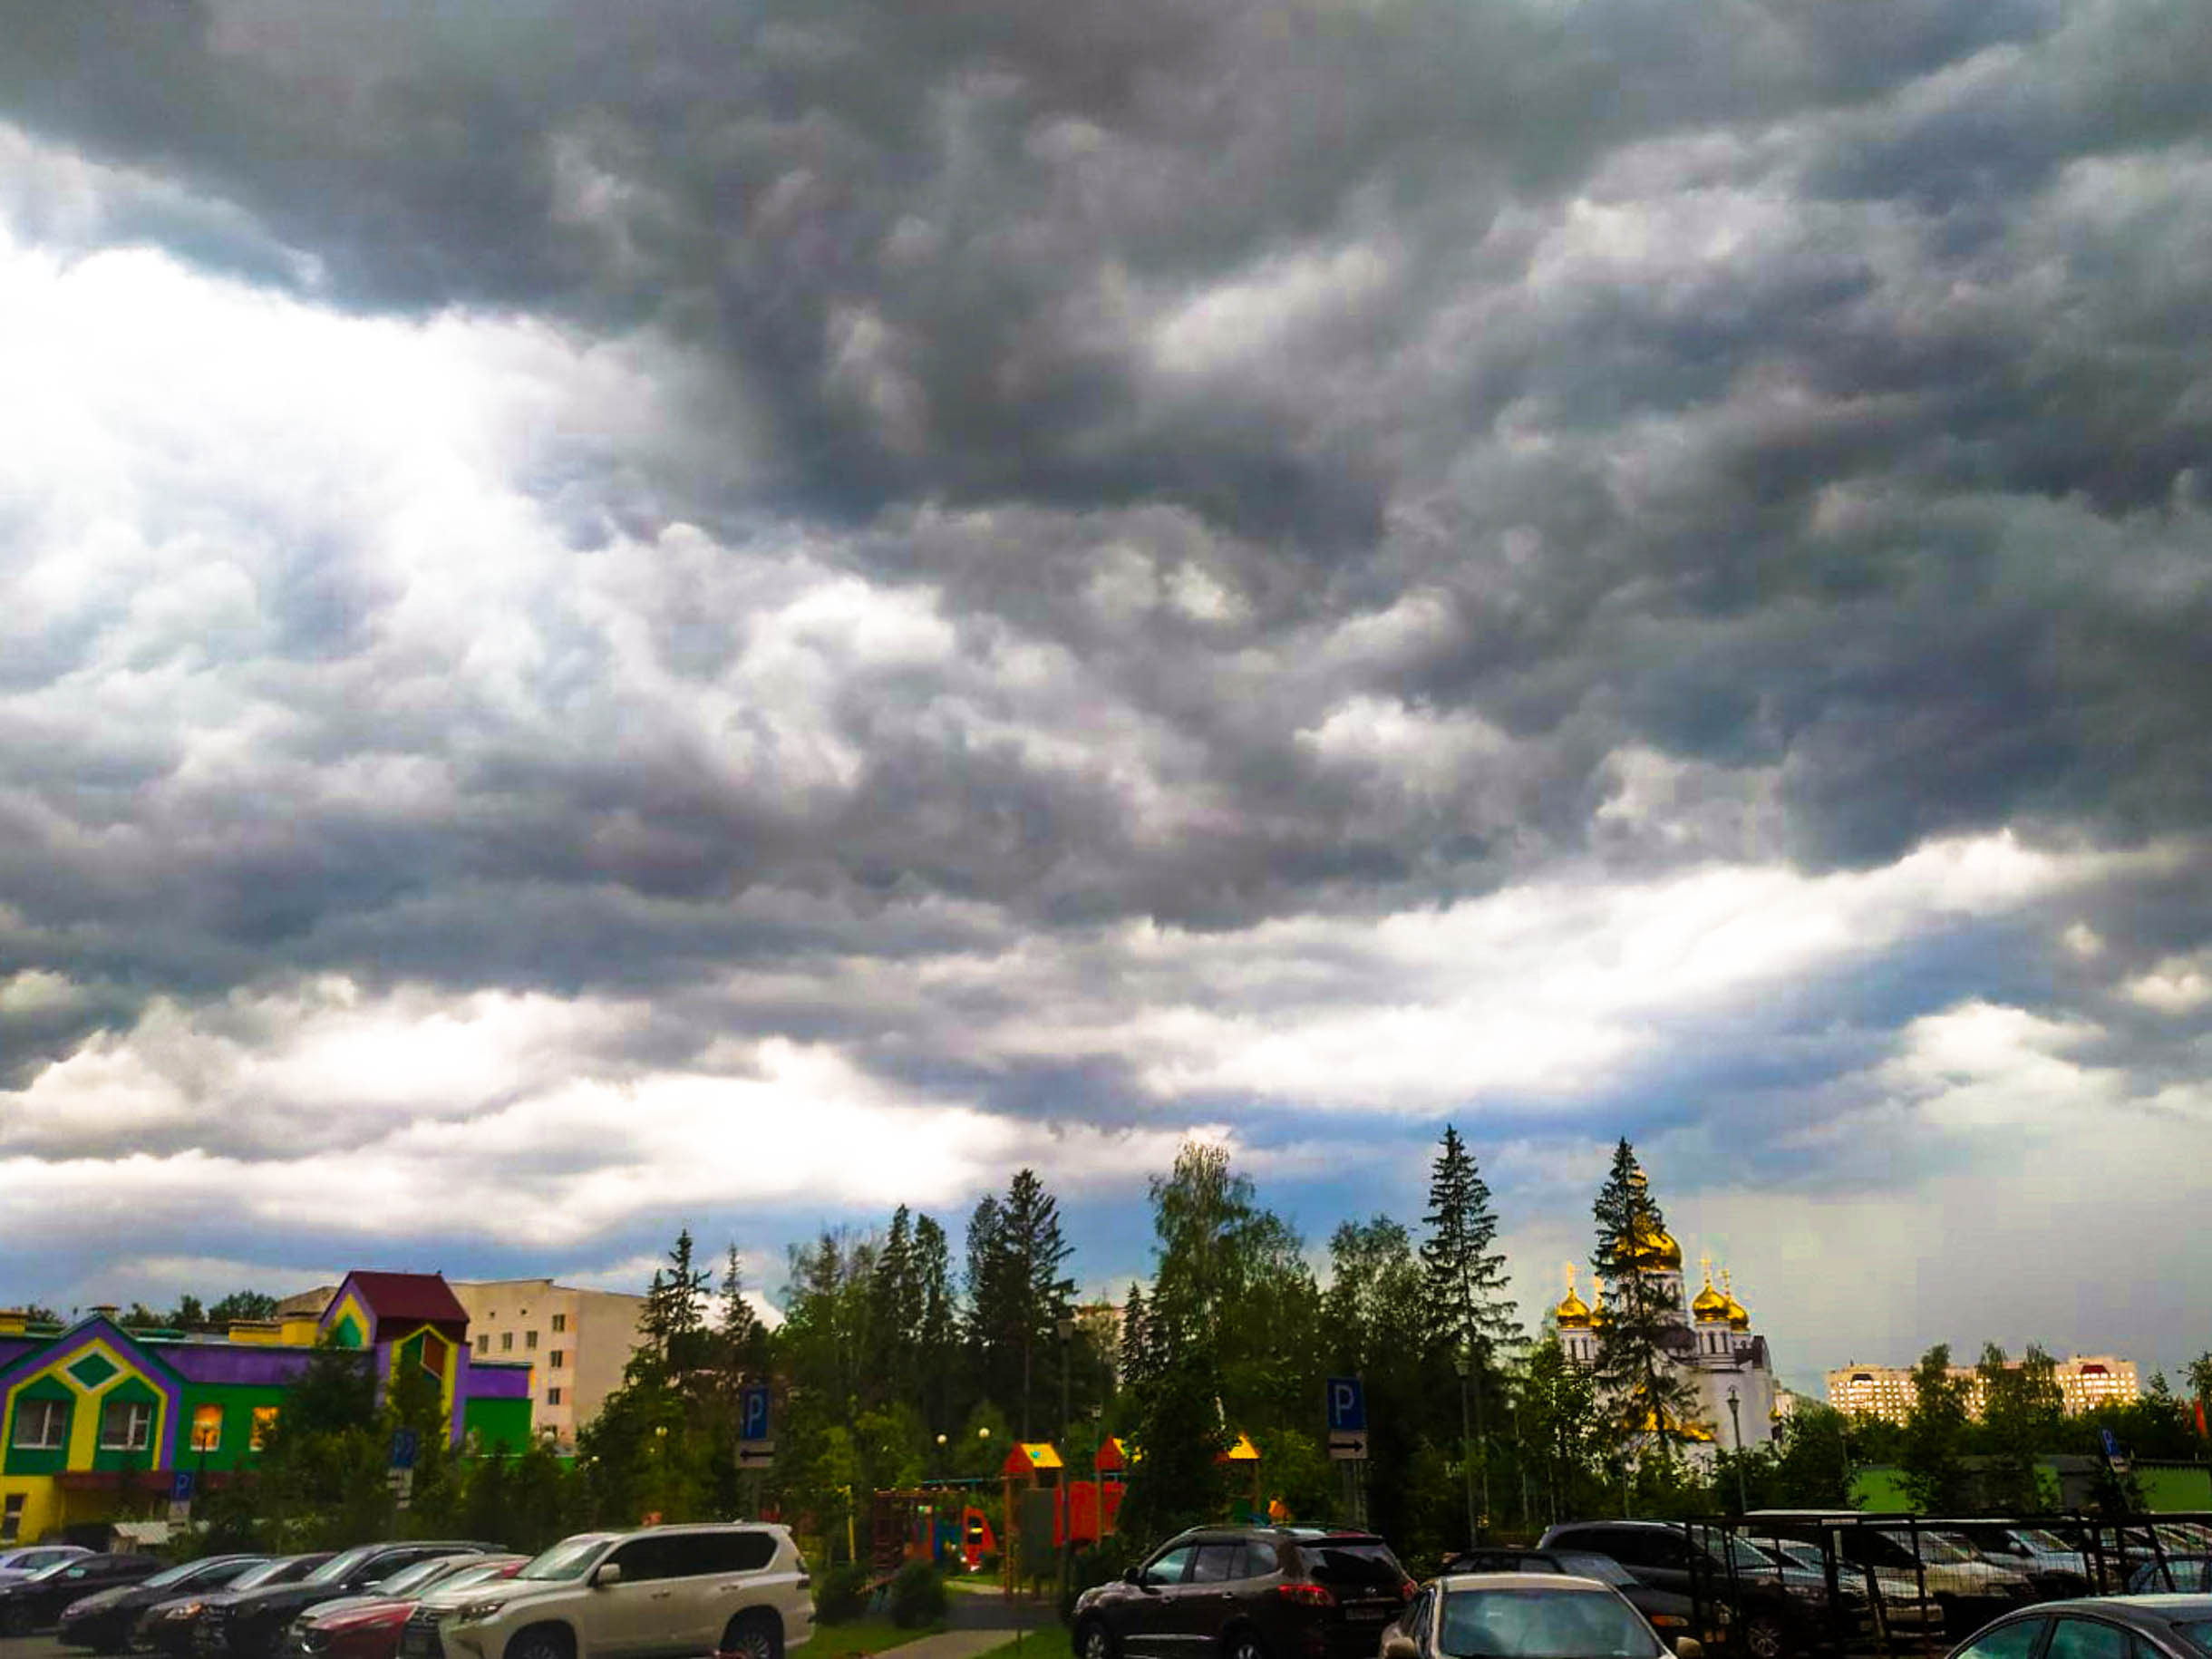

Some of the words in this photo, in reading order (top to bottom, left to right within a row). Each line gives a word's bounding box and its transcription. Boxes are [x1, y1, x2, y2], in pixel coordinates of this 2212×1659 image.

[747, 1394, 763, 1437] P
[1334, 1384, 1354, 1426] P
[176, 1474, 189, 1498] P
